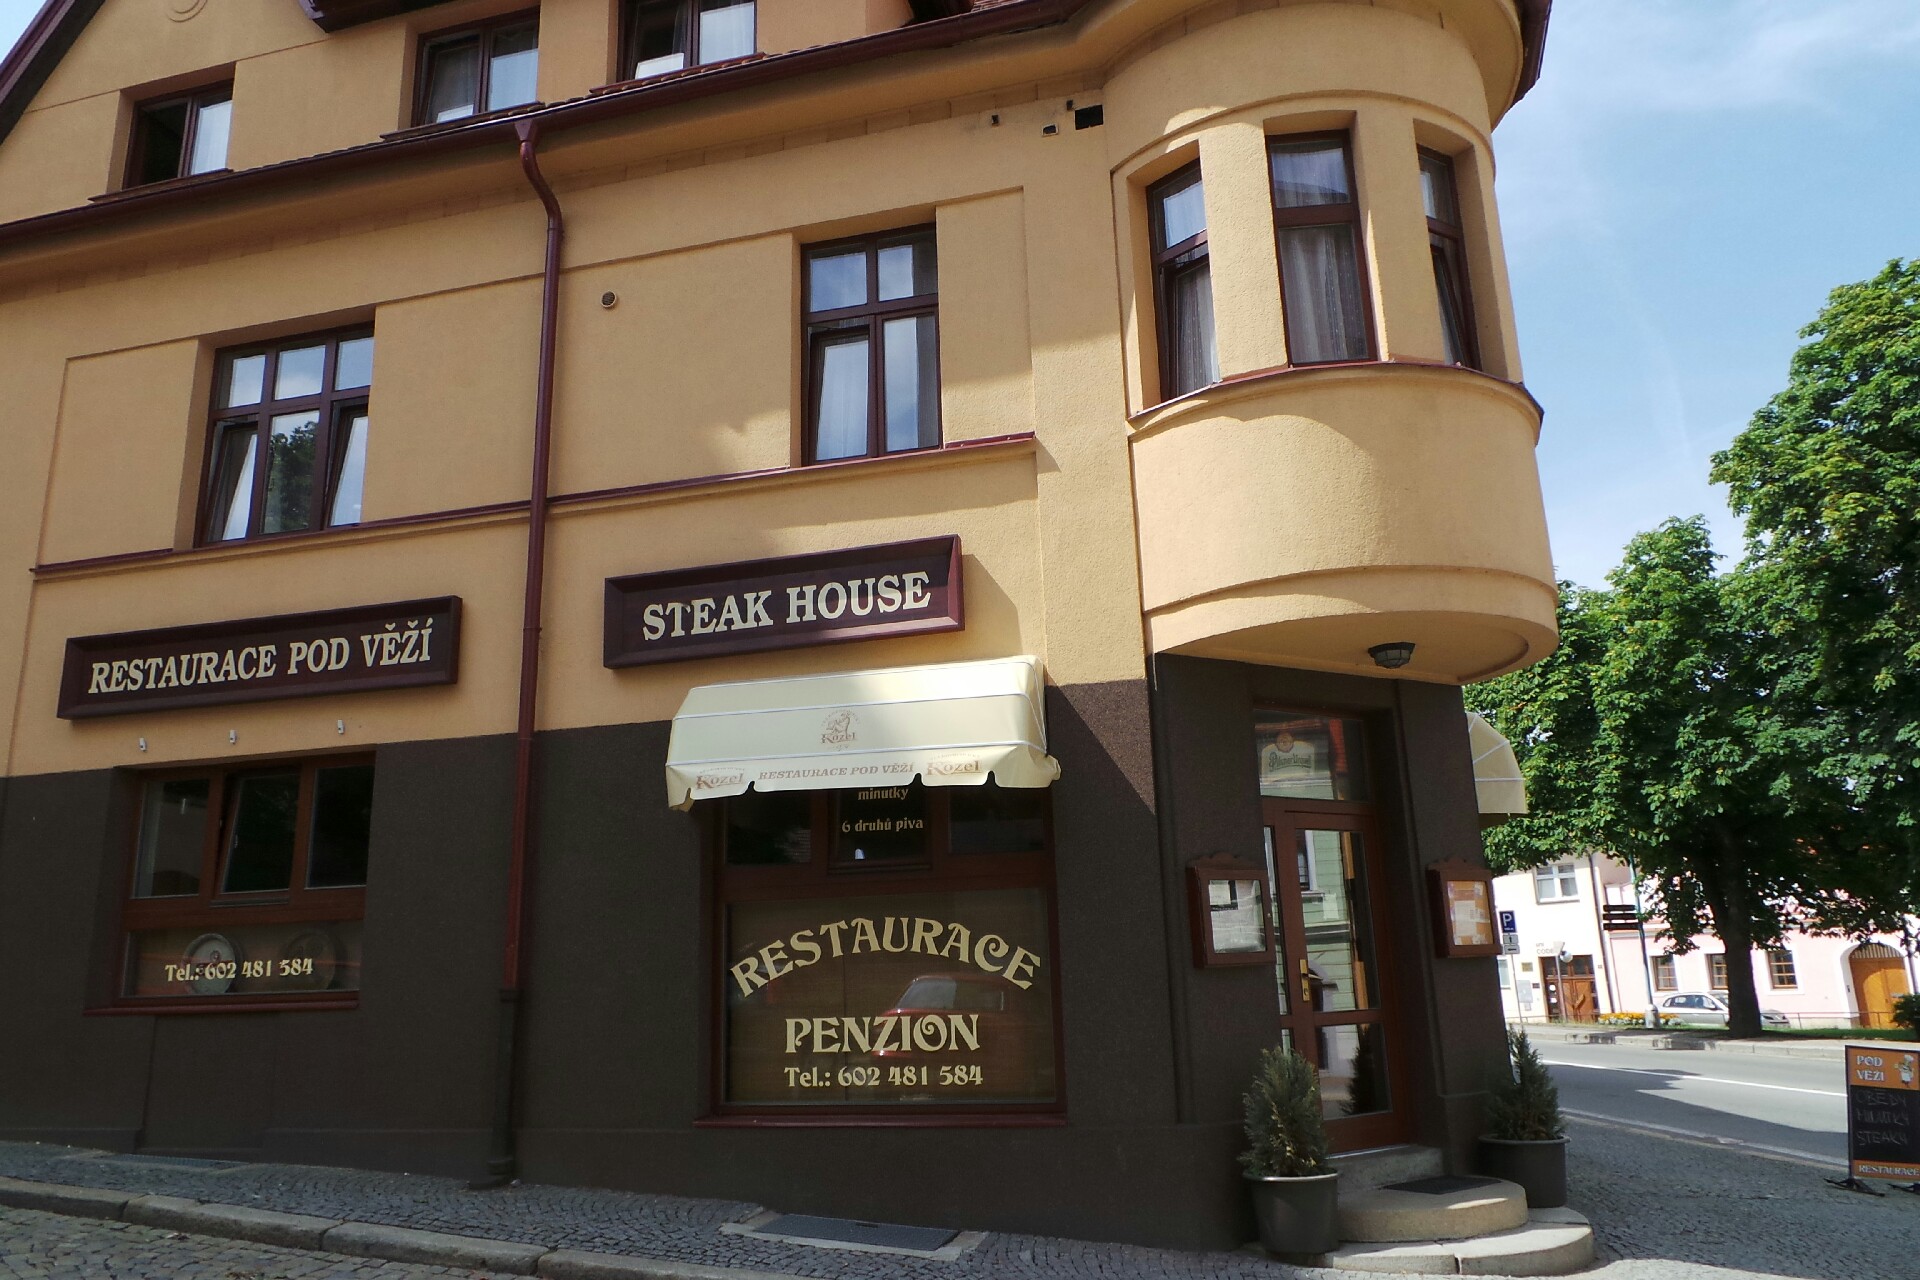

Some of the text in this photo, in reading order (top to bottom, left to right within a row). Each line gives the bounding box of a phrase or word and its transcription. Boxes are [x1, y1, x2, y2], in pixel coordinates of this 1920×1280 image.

[642, 571, 931, 641] STEAK HOUSE
[88, 617, 434, 694] RESTAURACE POD VĚŽÍ
[758, 767, 848, 781] RESTAURACE
[850, 765, 879, 776] POD
[882, 761, 914, 774] VĚŽÍ
[926, 760, 983, 776] Kozel
[696, 772, 746, 791] Kozel
[857, 786, 909, 801] minutky
[841, 817, 924, 833] 6 druhů piva
[1502, 913, 1513, 927] P
[730, 917, 1041, 998] RESTAURACE
[165, 958, 313, 982] Tel.: 602 481 584
[785, 1014, 980, 1054] PENZION
[1856, 1055, 1883, 1066] POD
[784, 1064, 984, 1088] Tel.: 602 481 584
[1859, 1165, 1920, 1176] RESTAURACE
